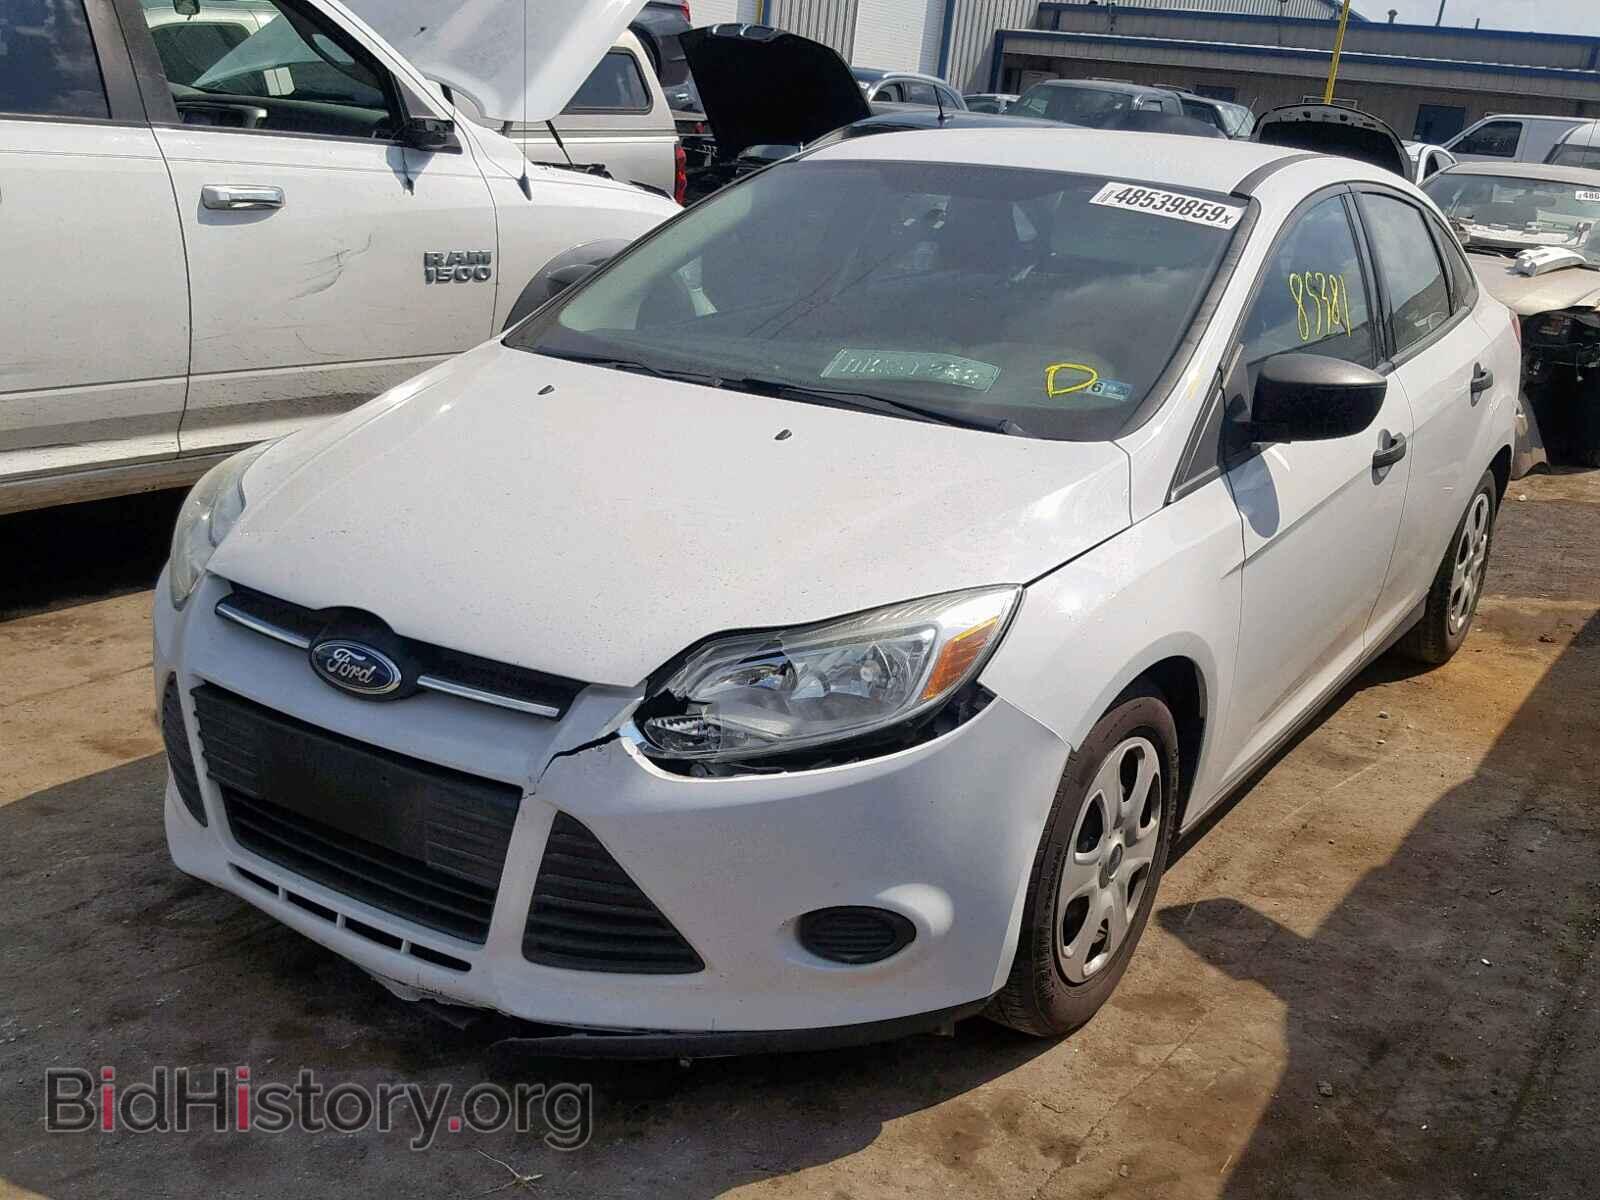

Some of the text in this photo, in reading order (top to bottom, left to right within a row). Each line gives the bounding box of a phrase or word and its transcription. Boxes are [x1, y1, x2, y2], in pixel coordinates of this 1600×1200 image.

[424, 250, 492, 266] RAM
[424, 266, 492, 284] 1500
[326, 647, 377, 684] Ford
